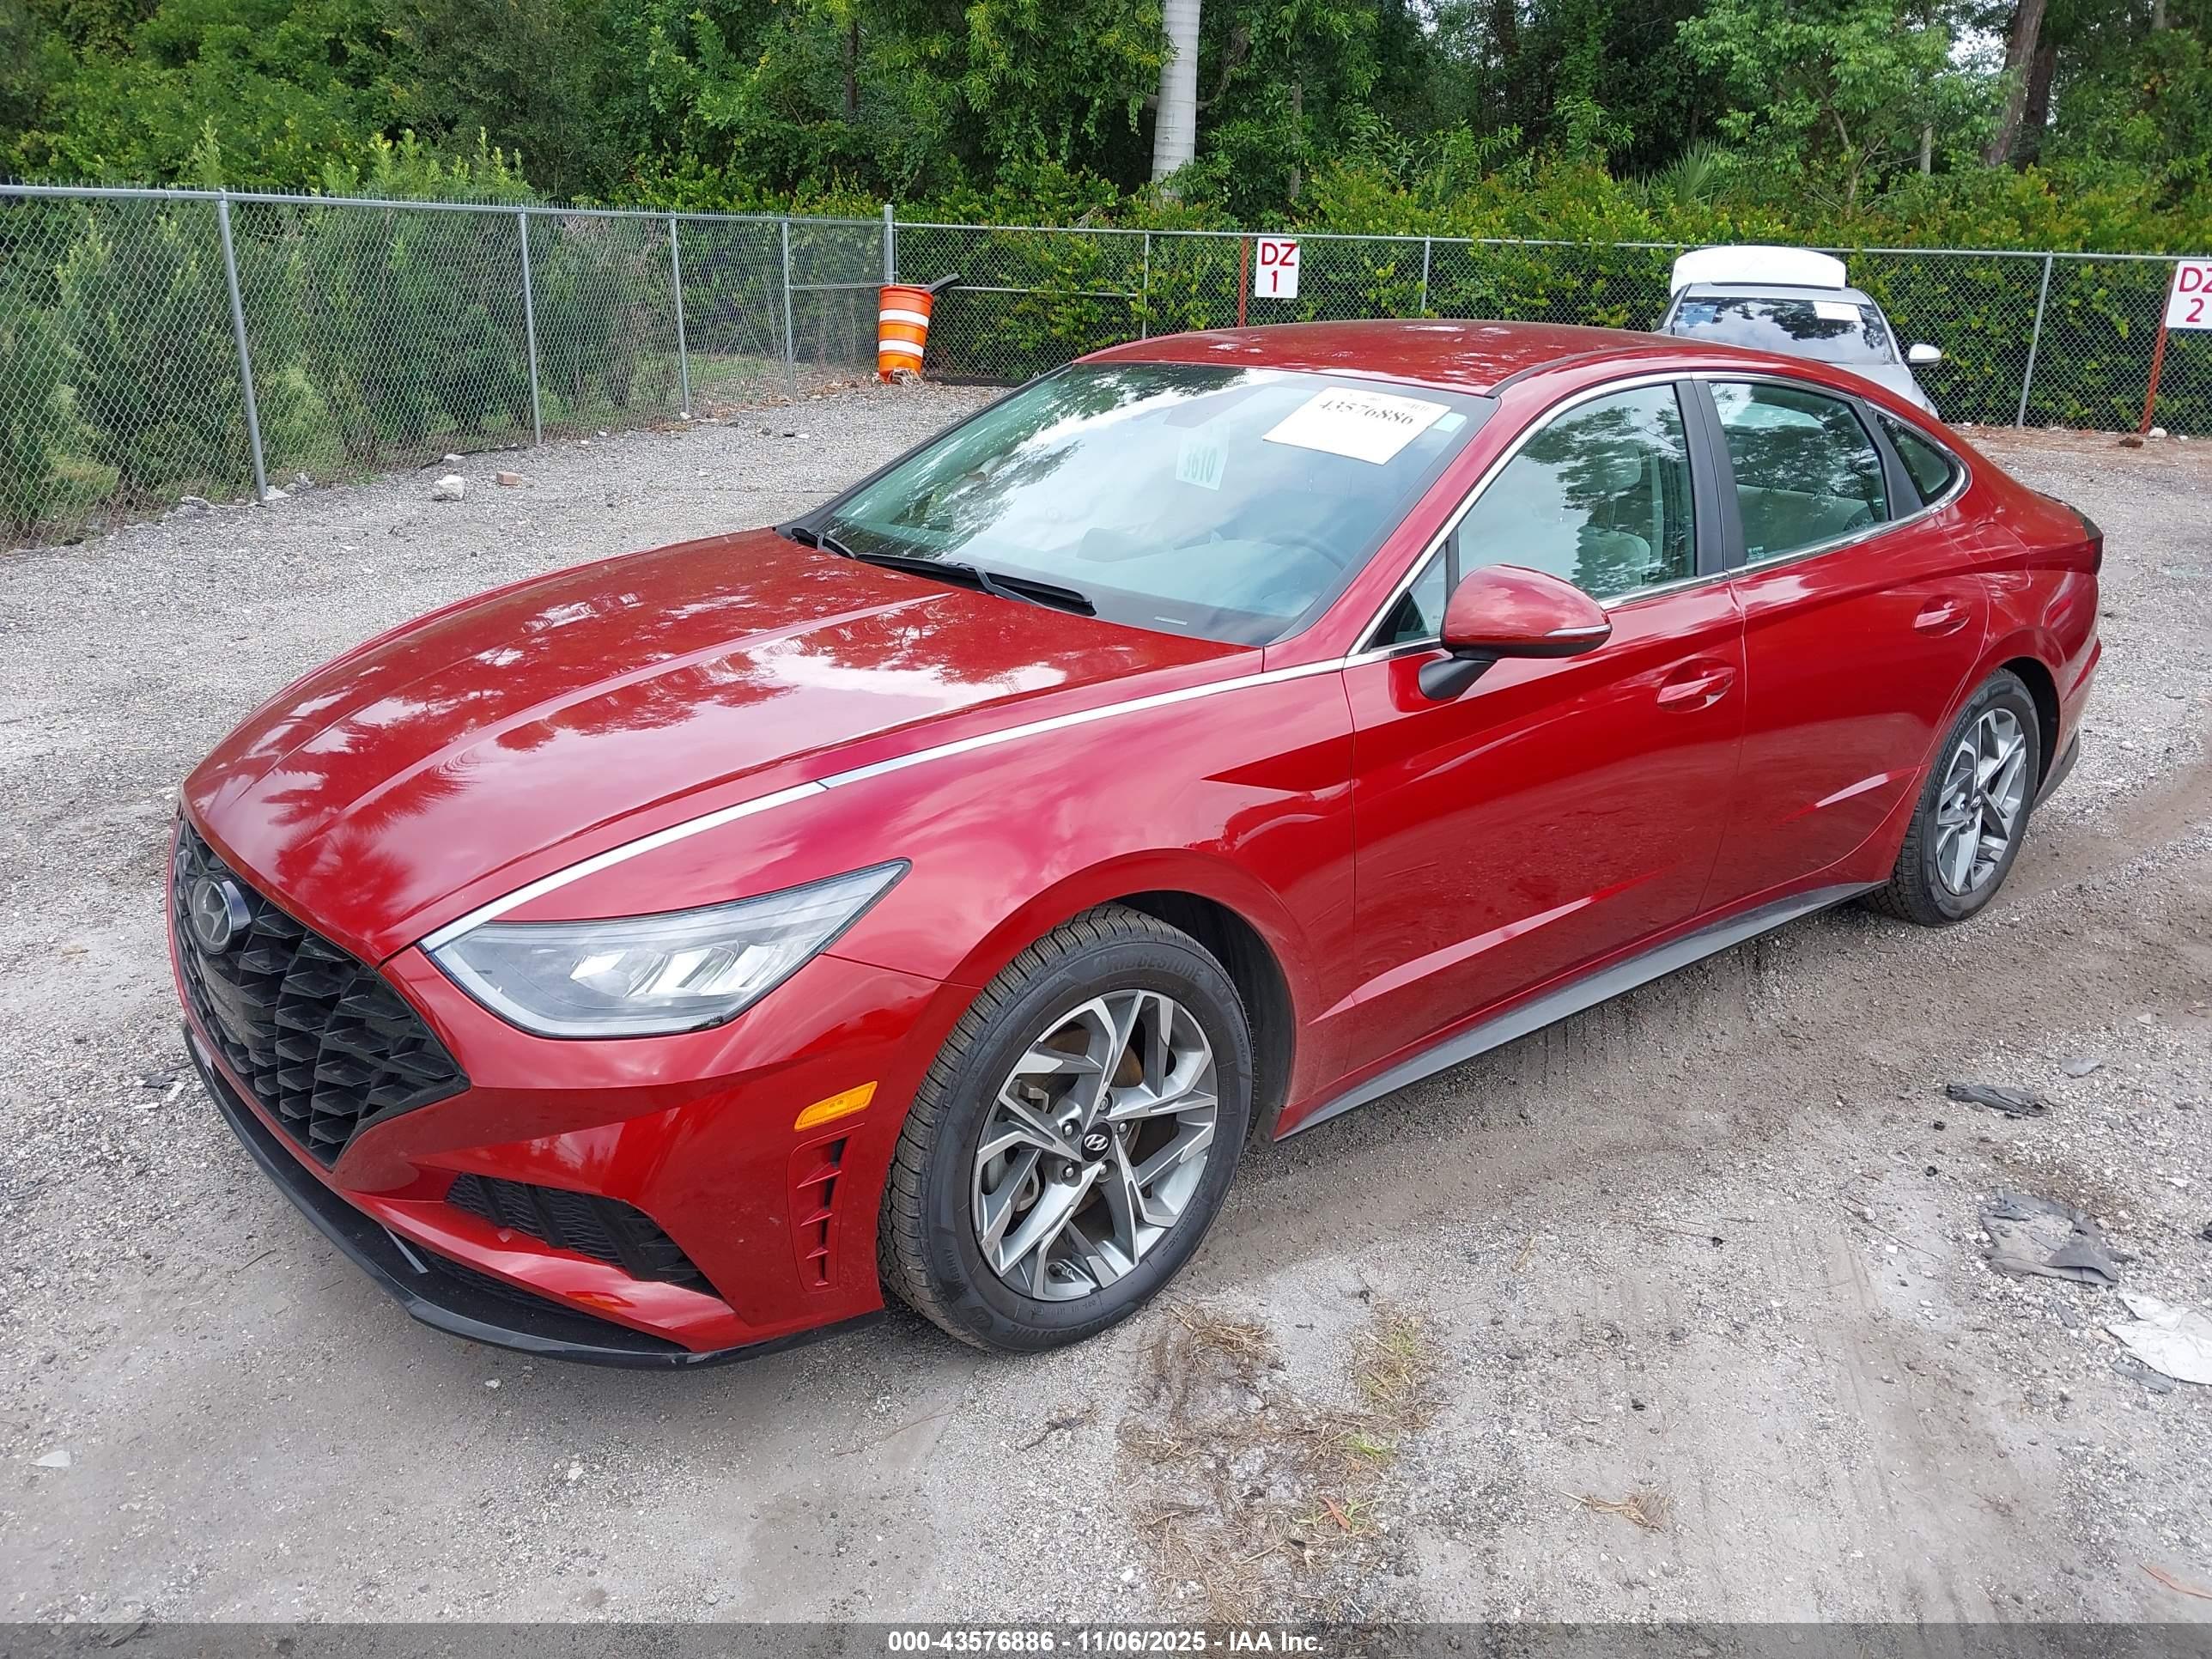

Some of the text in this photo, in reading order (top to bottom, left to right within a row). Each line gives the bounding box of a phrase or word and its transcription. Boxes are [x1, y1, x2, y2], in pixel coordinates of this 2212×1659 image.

[1261, 242, 1297, 266] DZ
[1271, 270, 1279, 293] 1
[2185, 297, 2205, 323] 2
